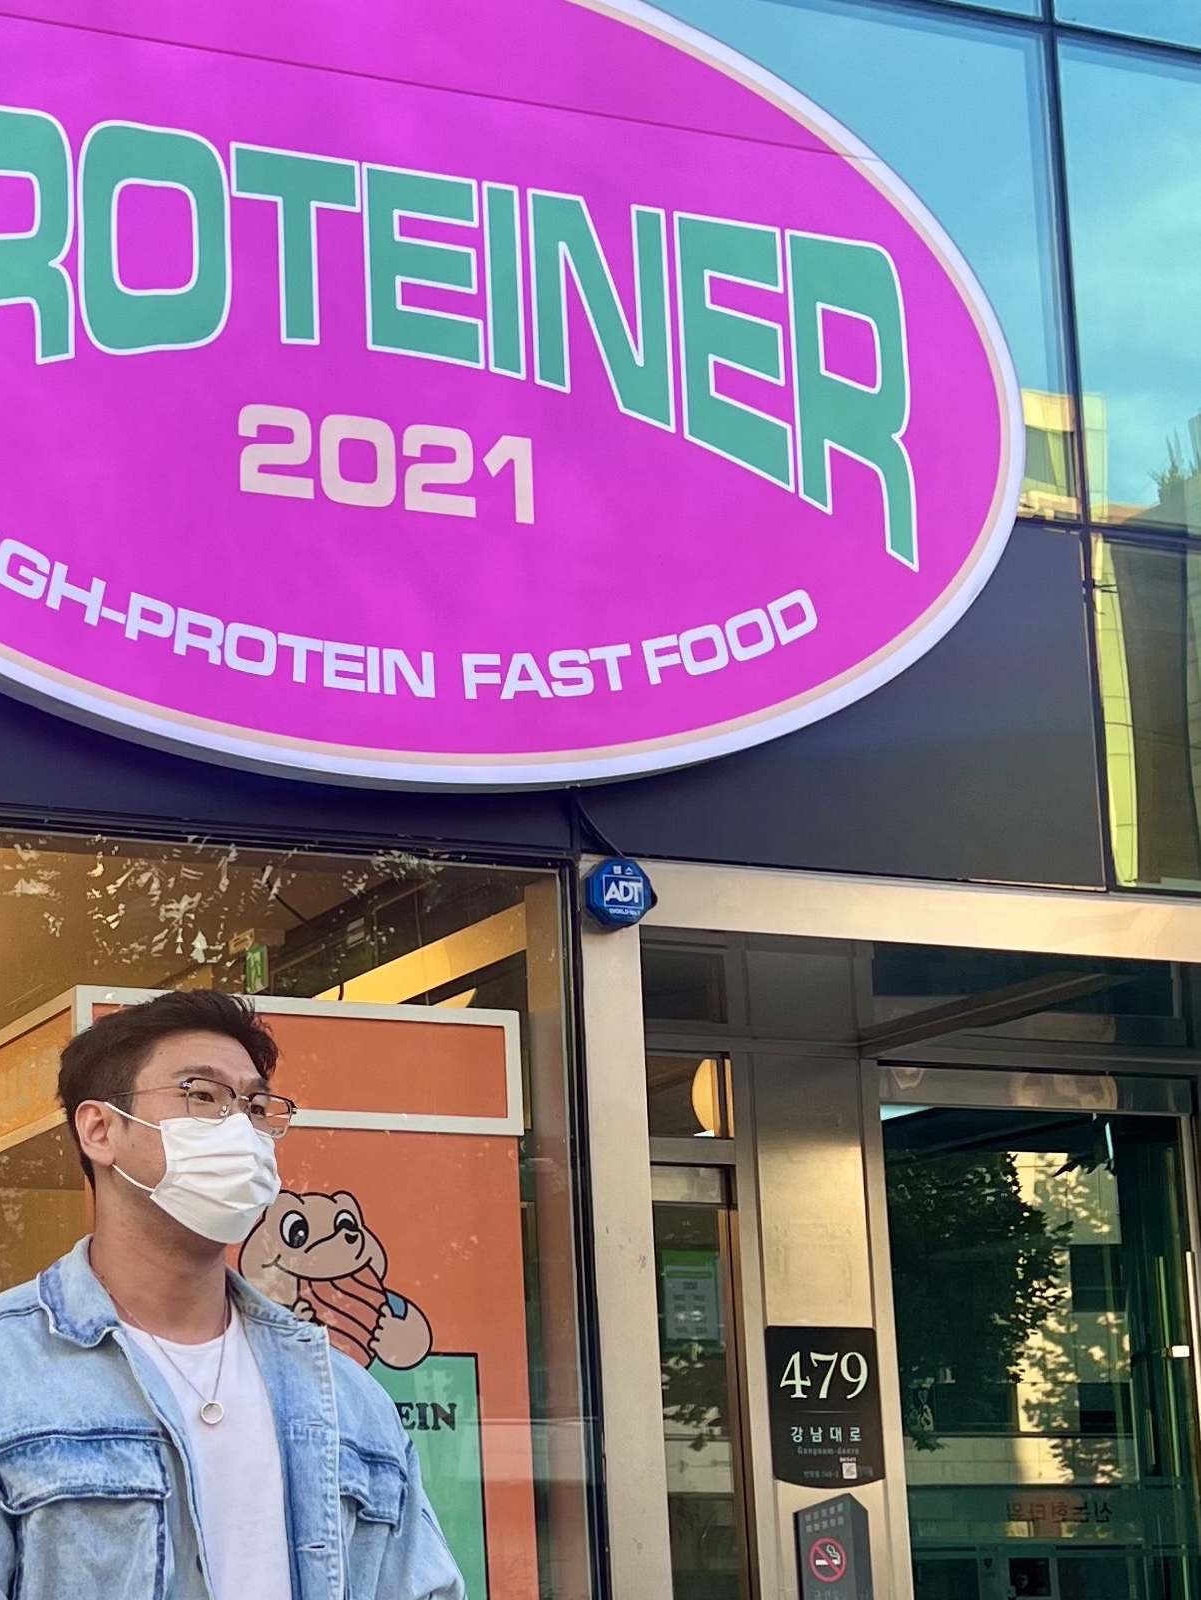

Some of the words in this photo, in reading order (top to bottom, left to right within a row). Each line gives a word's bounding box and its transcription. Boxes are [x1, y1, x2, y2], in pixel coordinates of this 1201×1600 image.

[237, 402, 536, 525] 2021
[462, 645, 631, 702] FAST
[643, 588, 819, 688] FOOD
[604, 880, 643, 904] ADT
[779, 1351, 868, 1399] 479
[790, 1426, 862, 1443] 강남대로
